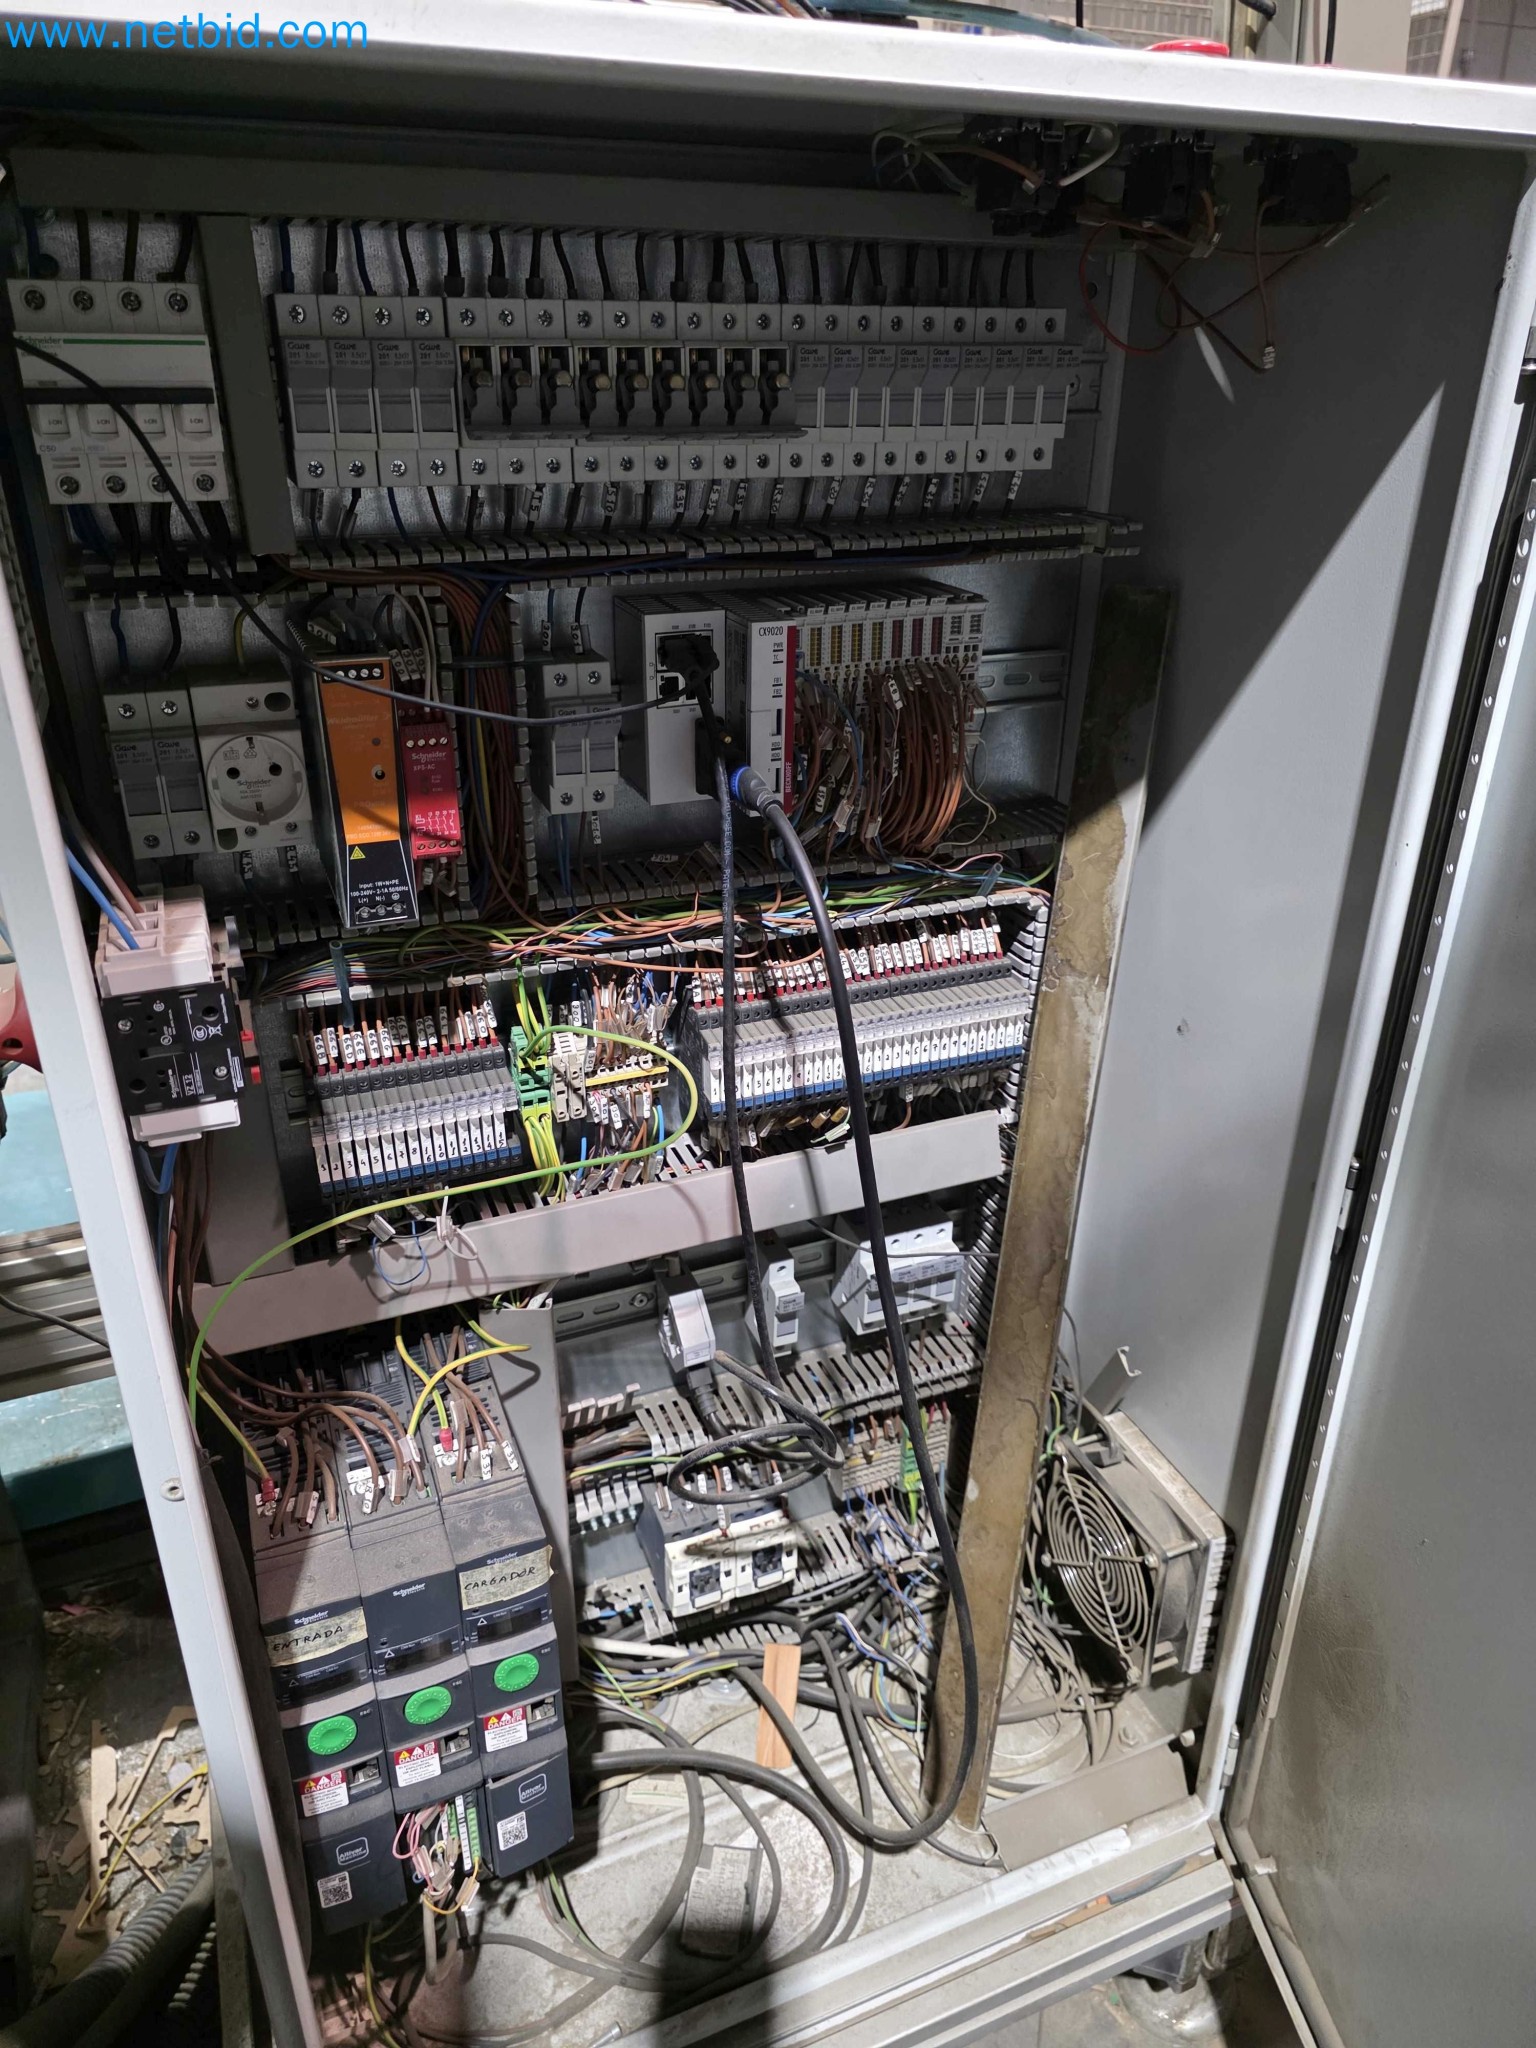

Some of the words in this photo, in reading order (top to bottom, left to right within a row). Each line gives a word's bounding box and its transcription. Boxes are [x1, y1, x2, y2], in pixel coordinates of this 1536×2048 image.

[758, 626, 783, 637] CX9020
[412, 752, 447, 764] Schneider
[236, 778, 273, 790] Schneider
[359, 882, 374, 890] Input:
[343, 1037, 353, 1059] 66D
[368, 1033, 379, 1054] 66F
[382, 1030, 391, 1051] 66G
[464, 1566, 536, 1591] CARGADOR
[393, 1582, 426, 1598] Schneider
[294, 1610, 329, 1625] Schneider
[273, 1625, 343, 1652] ENTRADA
[487, 1715, 523, 1730] DANGER
[399, 1749, 435, 1765] DANGER
[304, 1779, 343, 1794] DANGER
